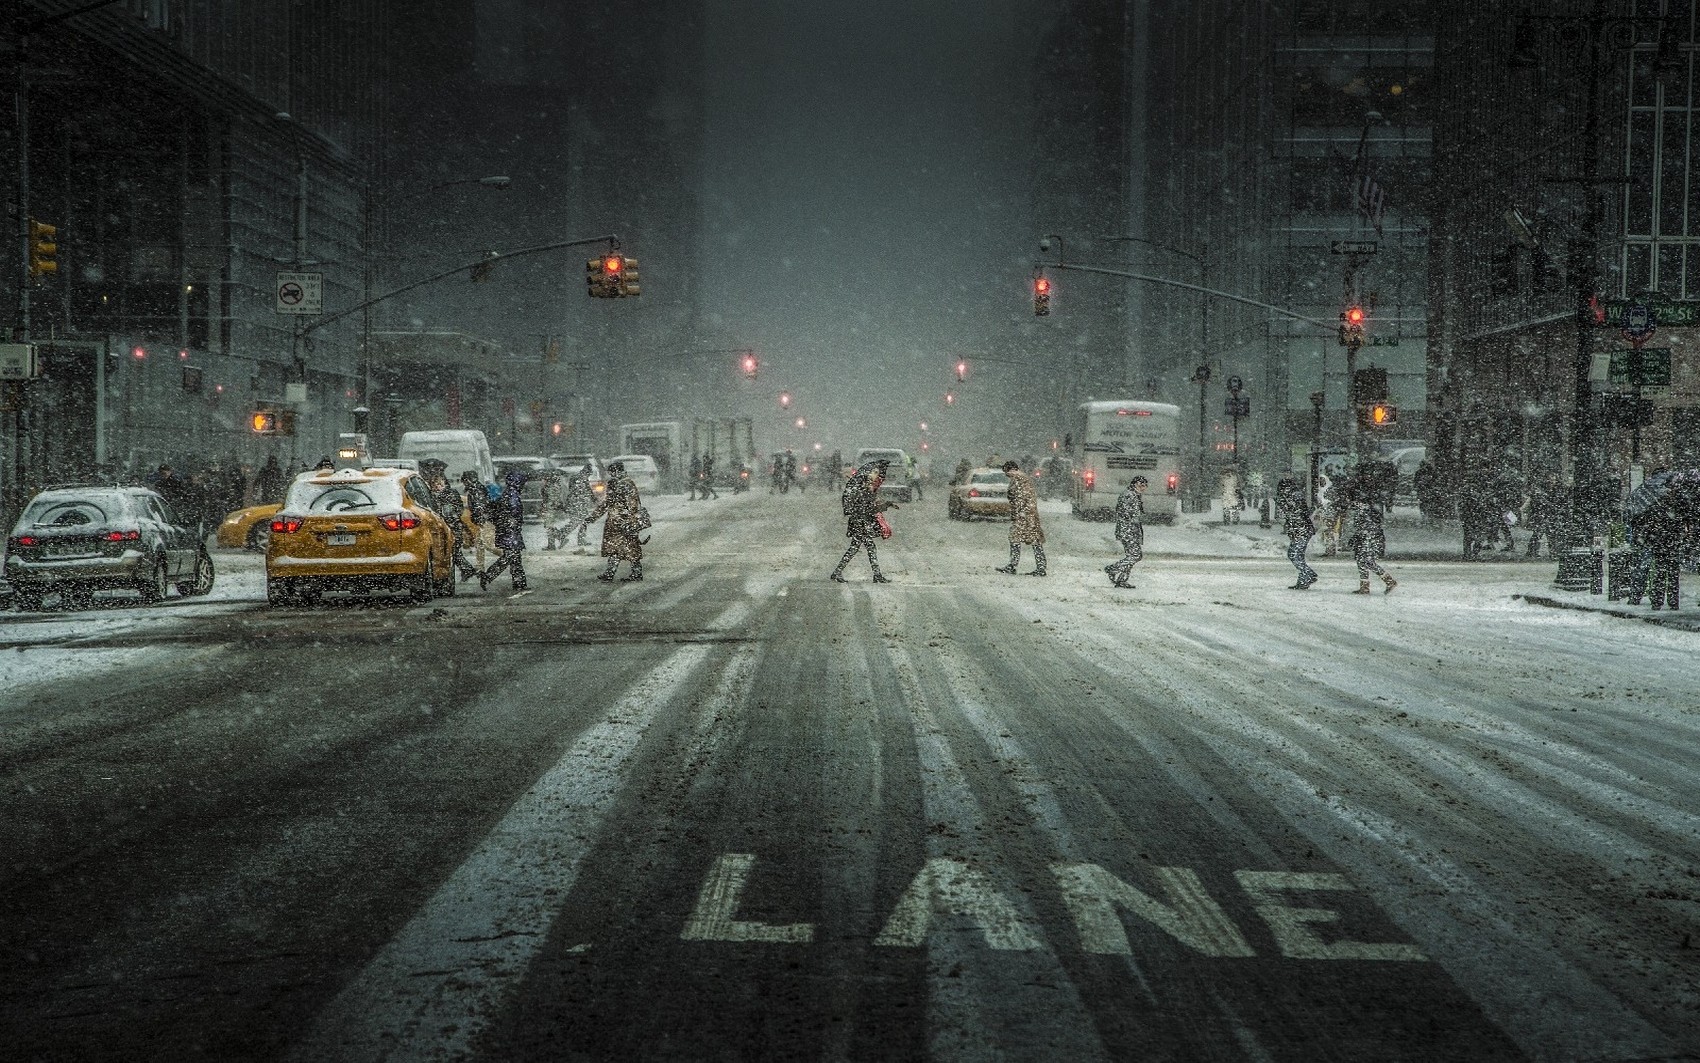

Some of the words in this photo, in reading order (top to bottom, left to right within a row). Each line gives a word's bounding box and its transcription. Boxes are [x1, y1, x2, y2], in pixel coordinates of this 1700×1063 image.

[1608, 307, 1623, 319] W
[1678, 308, 1694, 320] St
[680, 853, 1428, 961] LANE
